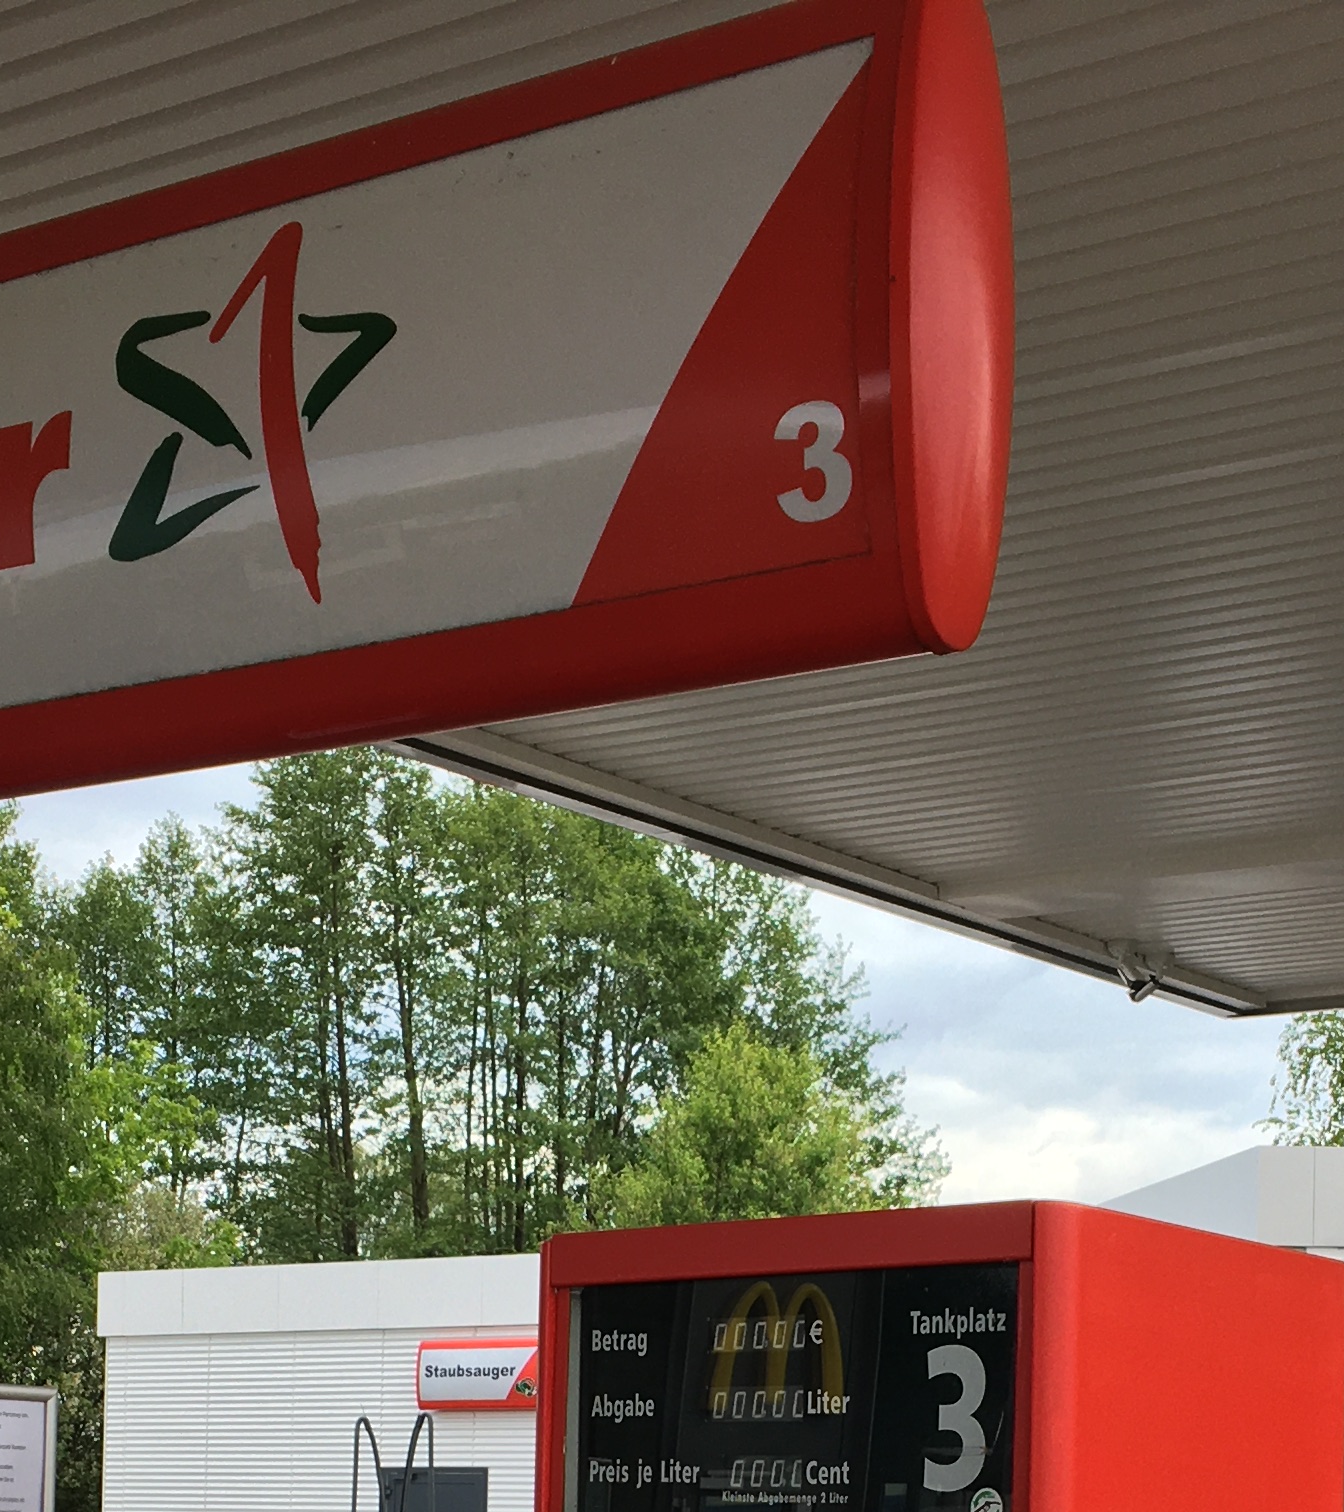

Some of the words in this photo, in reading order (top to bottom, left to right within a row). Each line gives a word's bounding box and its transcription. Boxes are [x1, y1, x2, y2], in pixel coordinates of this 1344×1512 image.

[773, 400, 853, 523] 3
[910, 1307, 1007, 1339] Tankplatz
[591, 1329, 648, 1357] Betrag
[424, 1364, 516, 1379] Staubsauger
[591, 1394, 655, 1423] Abgabe
[807, 1389, 850, 1415] Liter
[923, 1344, 987, 1492] 3
[589, 1459, 629, 1483] Preis
[636, 1460, 653, 1489] je
[660, 1459, 701, 1484] Liter
[806, 1459, 850, 1485] Cent
[722, 1491, 755, 1503] Kleinste
[757, 1491, 817, 1506] Abgabemenge
[820, 1492, 826, 1503] 2
[829, 1492, 849, 1504] Liter
